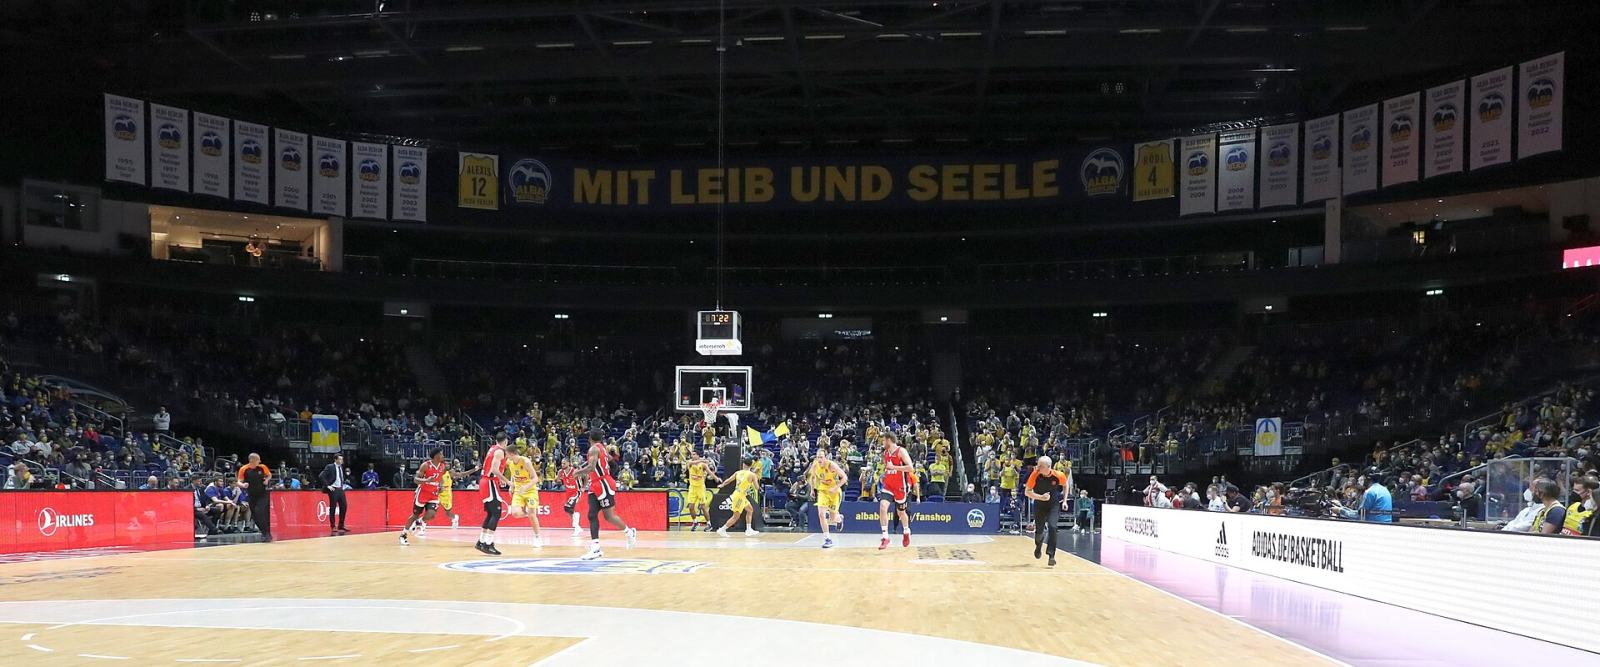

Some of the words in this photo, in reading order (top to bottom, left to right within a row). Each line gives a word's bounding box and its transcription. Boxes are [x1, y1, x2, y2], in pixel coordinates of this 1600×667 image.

[471, 177, 487, 197] 12
[574, 167, 656, 206] MIT
[670, 166, 775, 205] LEIB
[790, 165, 893, 202] UND
[906, 159, 1060, 202] SEELE
[1148, 166, 1157, 186] 4
[1251, 530, 1345, 573] ADIDAS.DE/BASKETBALL
